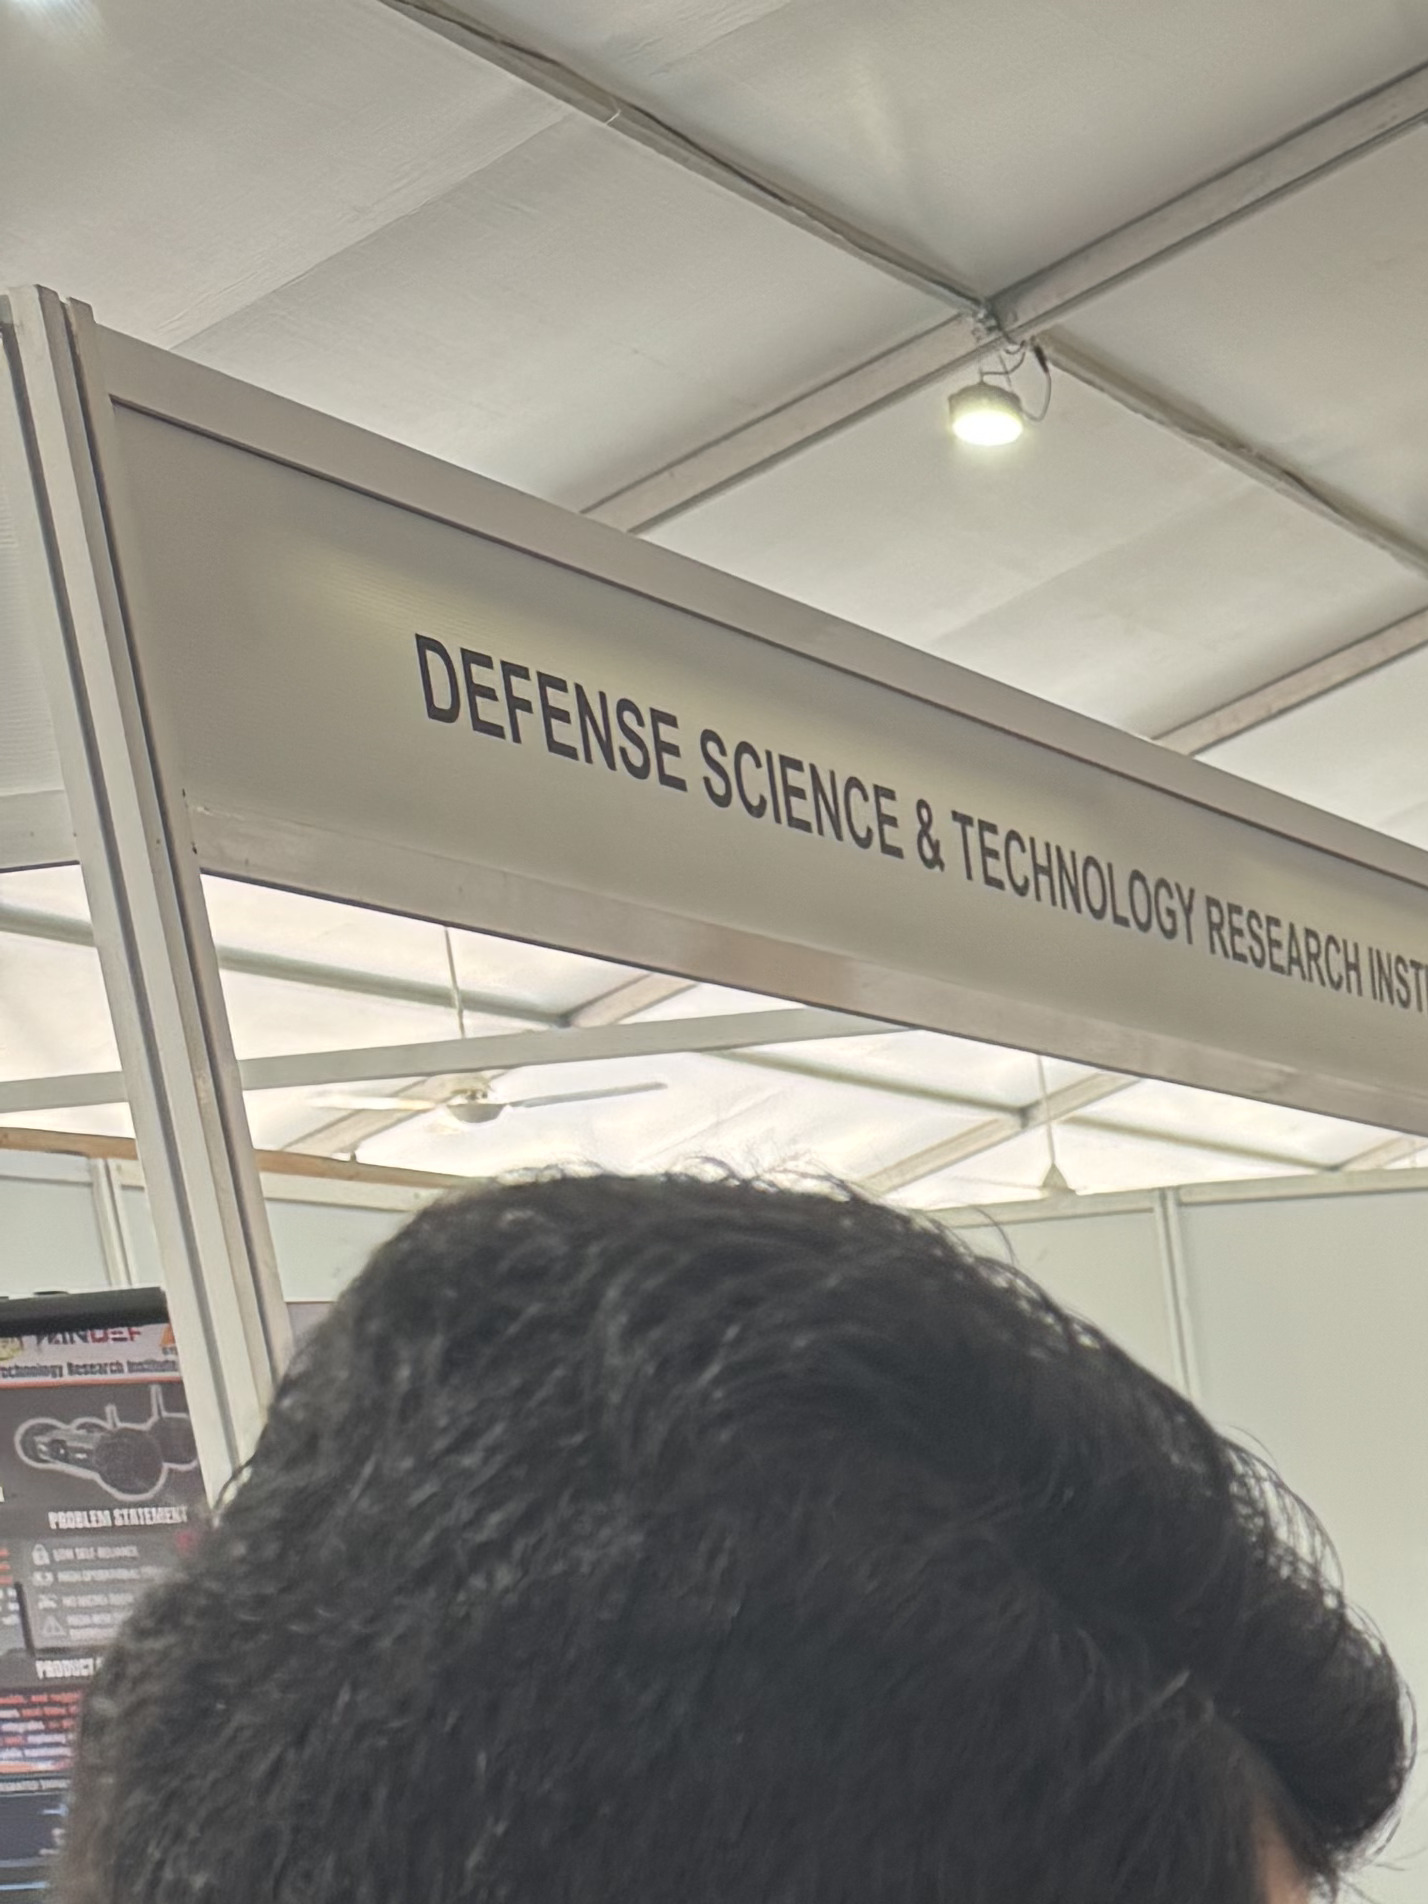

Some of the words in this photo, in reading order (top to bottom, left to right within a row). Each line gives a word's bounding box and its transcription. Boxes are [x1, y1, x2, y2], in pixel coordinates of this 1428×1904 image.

[414, 633, 688, 793] DEFENSE
[701, 728, 904, 860] SCIENCE
[916, 798, 945, 872] &
[951, 809, 1196, 946] TECHNOLOGY
[1205, 895, 1363, 997] RESEARCH
[0, 1364, 63, 1379] echnology
[48, 1509, 112, 1530] PROBLEM
[113, 1506, 188, 1527] STATEMENT
